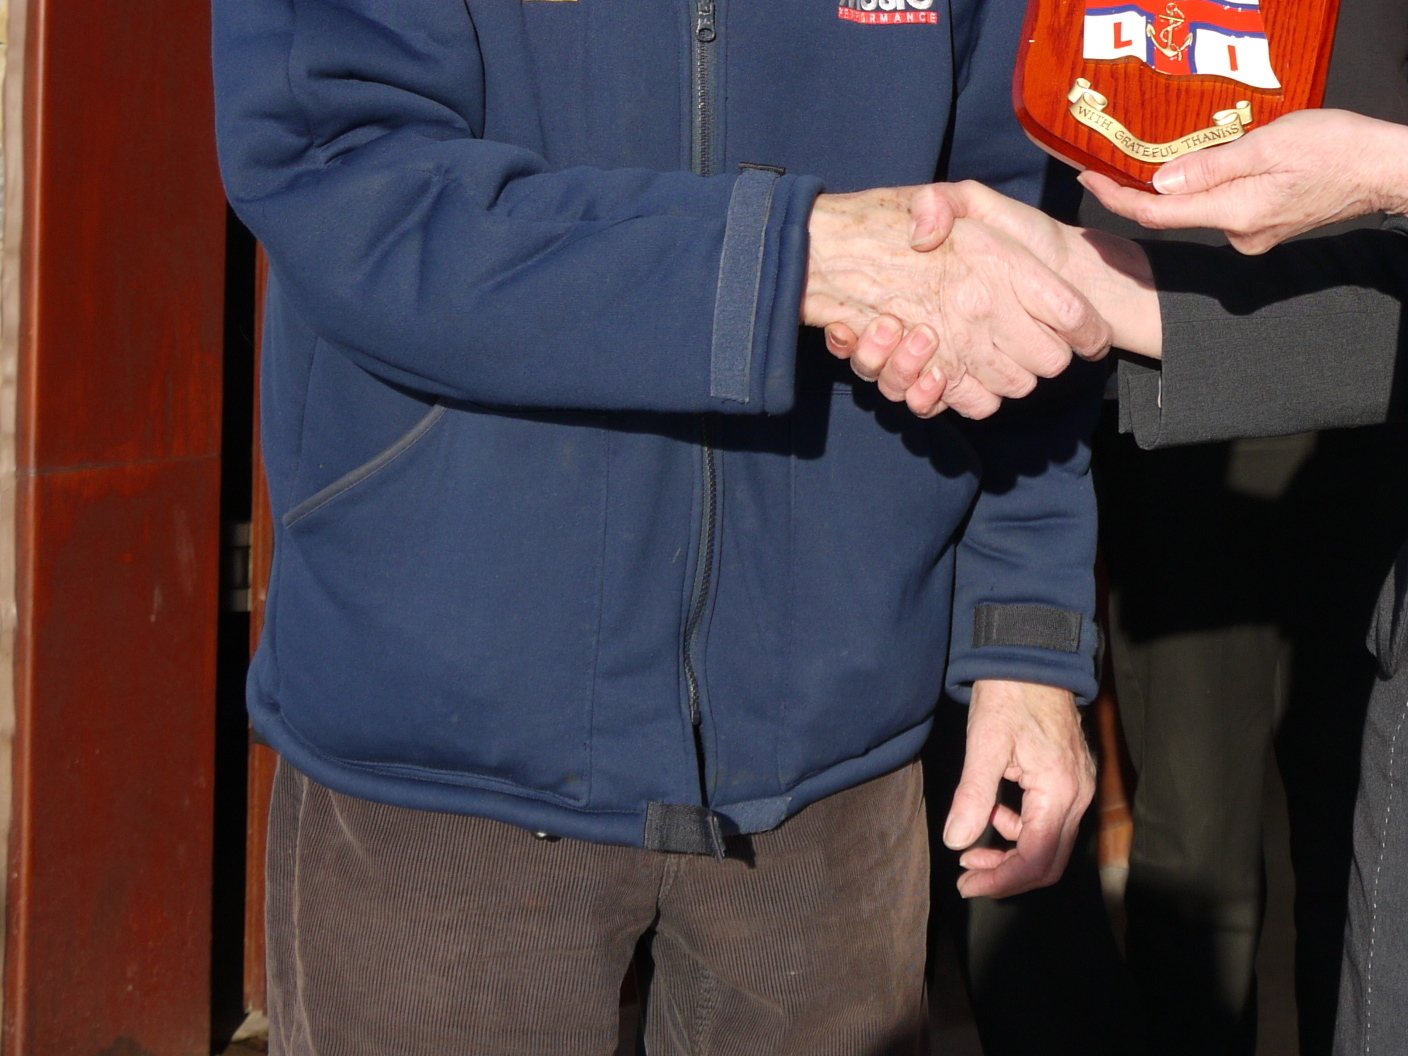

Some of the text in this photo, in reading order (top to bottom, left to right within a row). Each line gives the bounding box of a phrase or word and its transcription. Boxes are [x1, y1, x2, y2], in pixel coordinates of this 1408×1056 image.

[838, 7, 938, 24] PERFORMANCE
[1113, 22, 1239, 72] L I
[1077, 105, 1240, 158] WITH GRATEFUL THANKS
